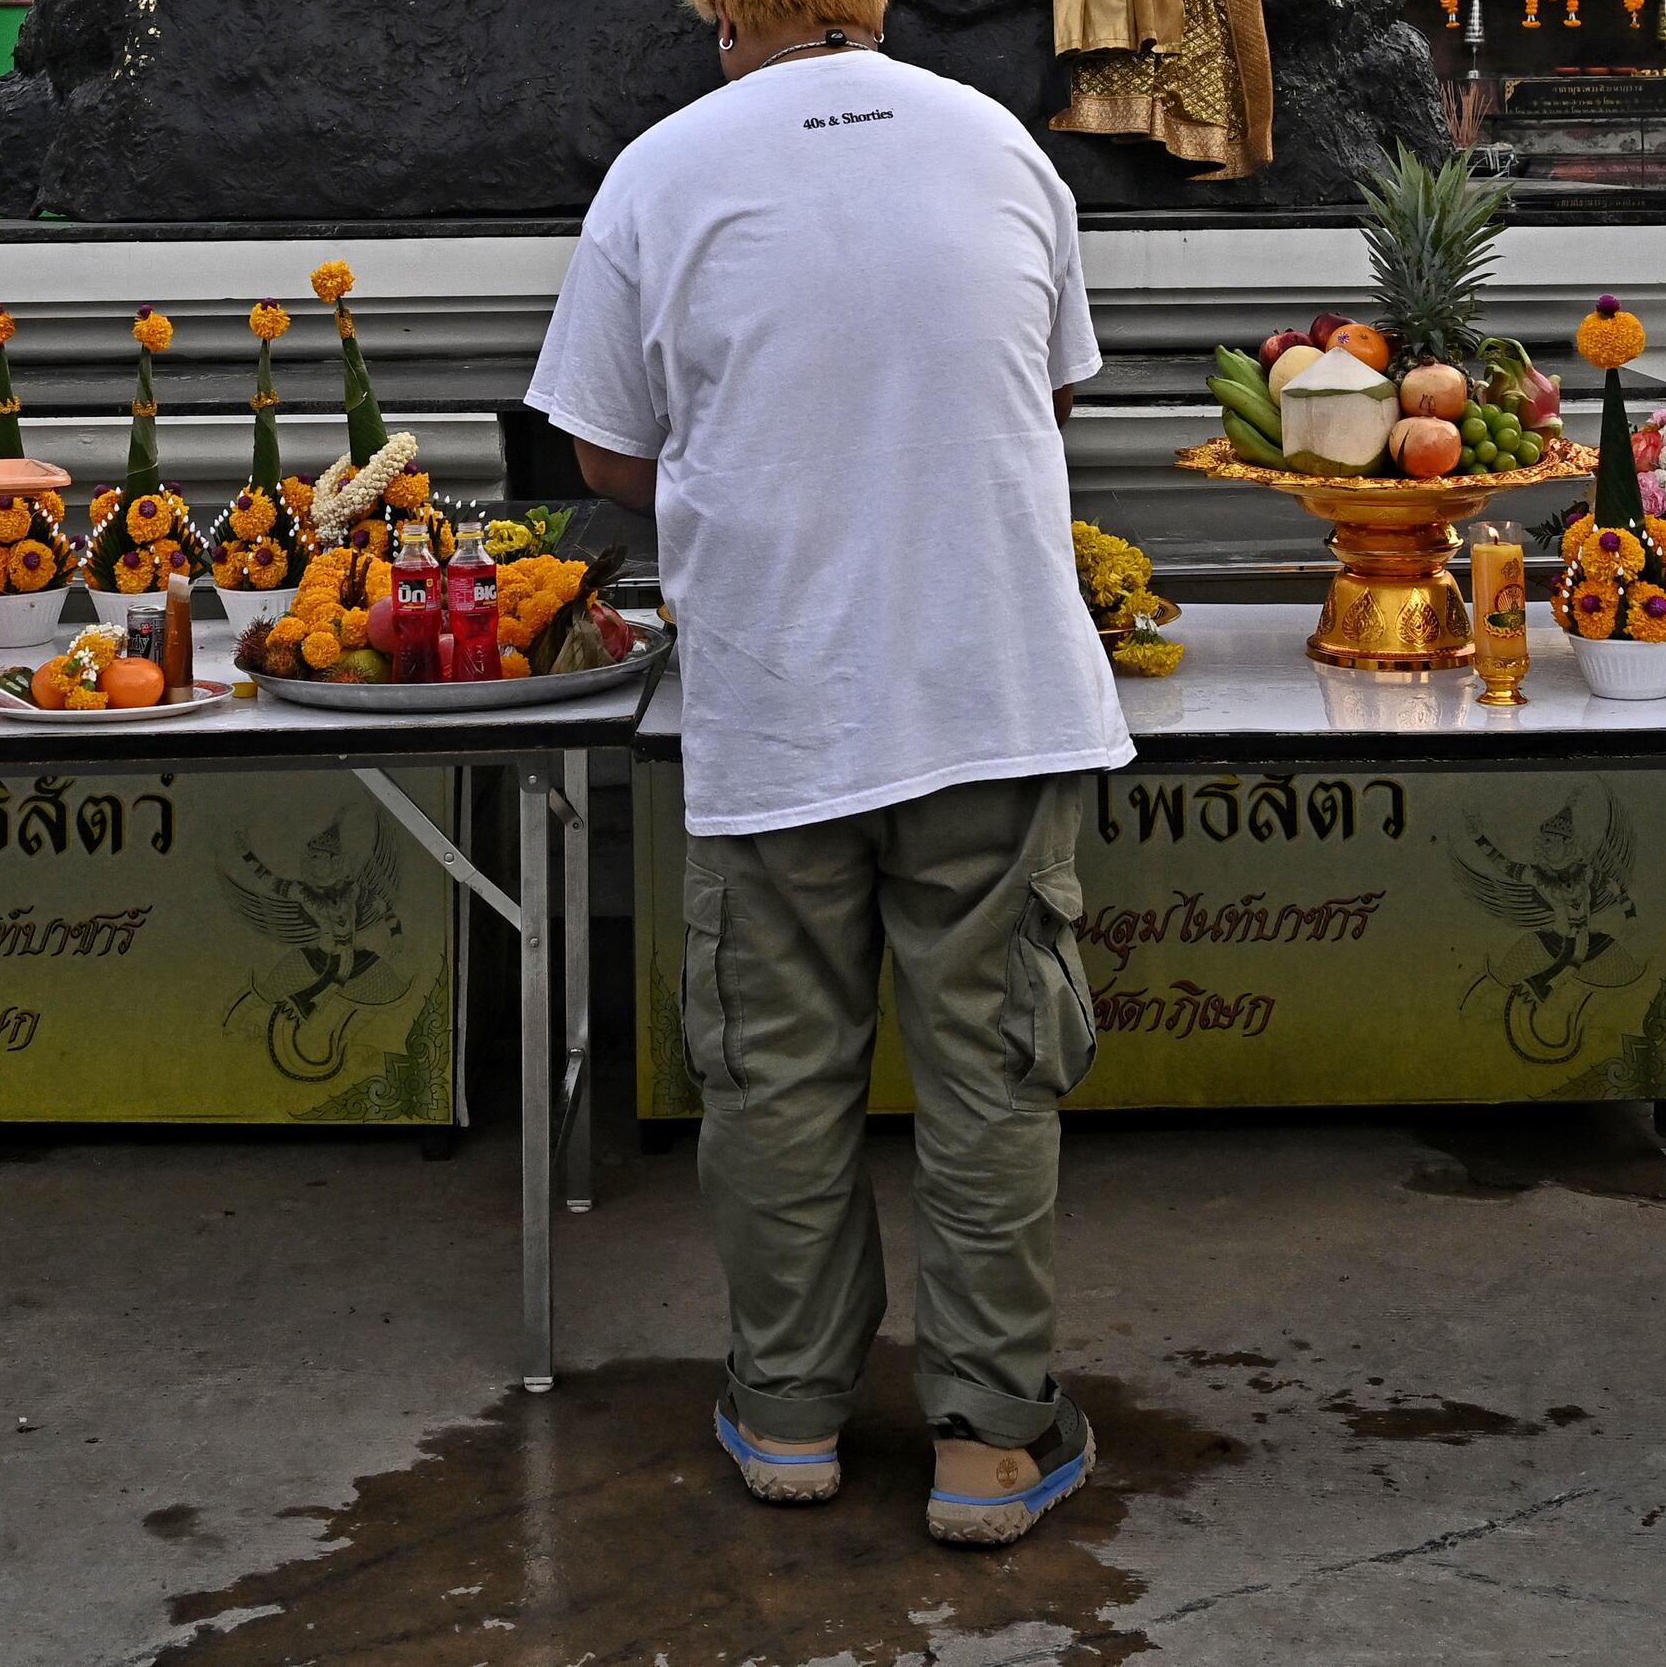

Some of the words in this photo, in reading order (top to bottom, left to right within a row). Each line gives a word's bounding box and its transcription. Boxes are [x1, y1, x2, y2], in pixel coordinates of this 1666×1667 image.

[803, 117, 826, 130] 40s
[828, 116, 840, 126] &
[841, 109, 894, 125] Shorties
